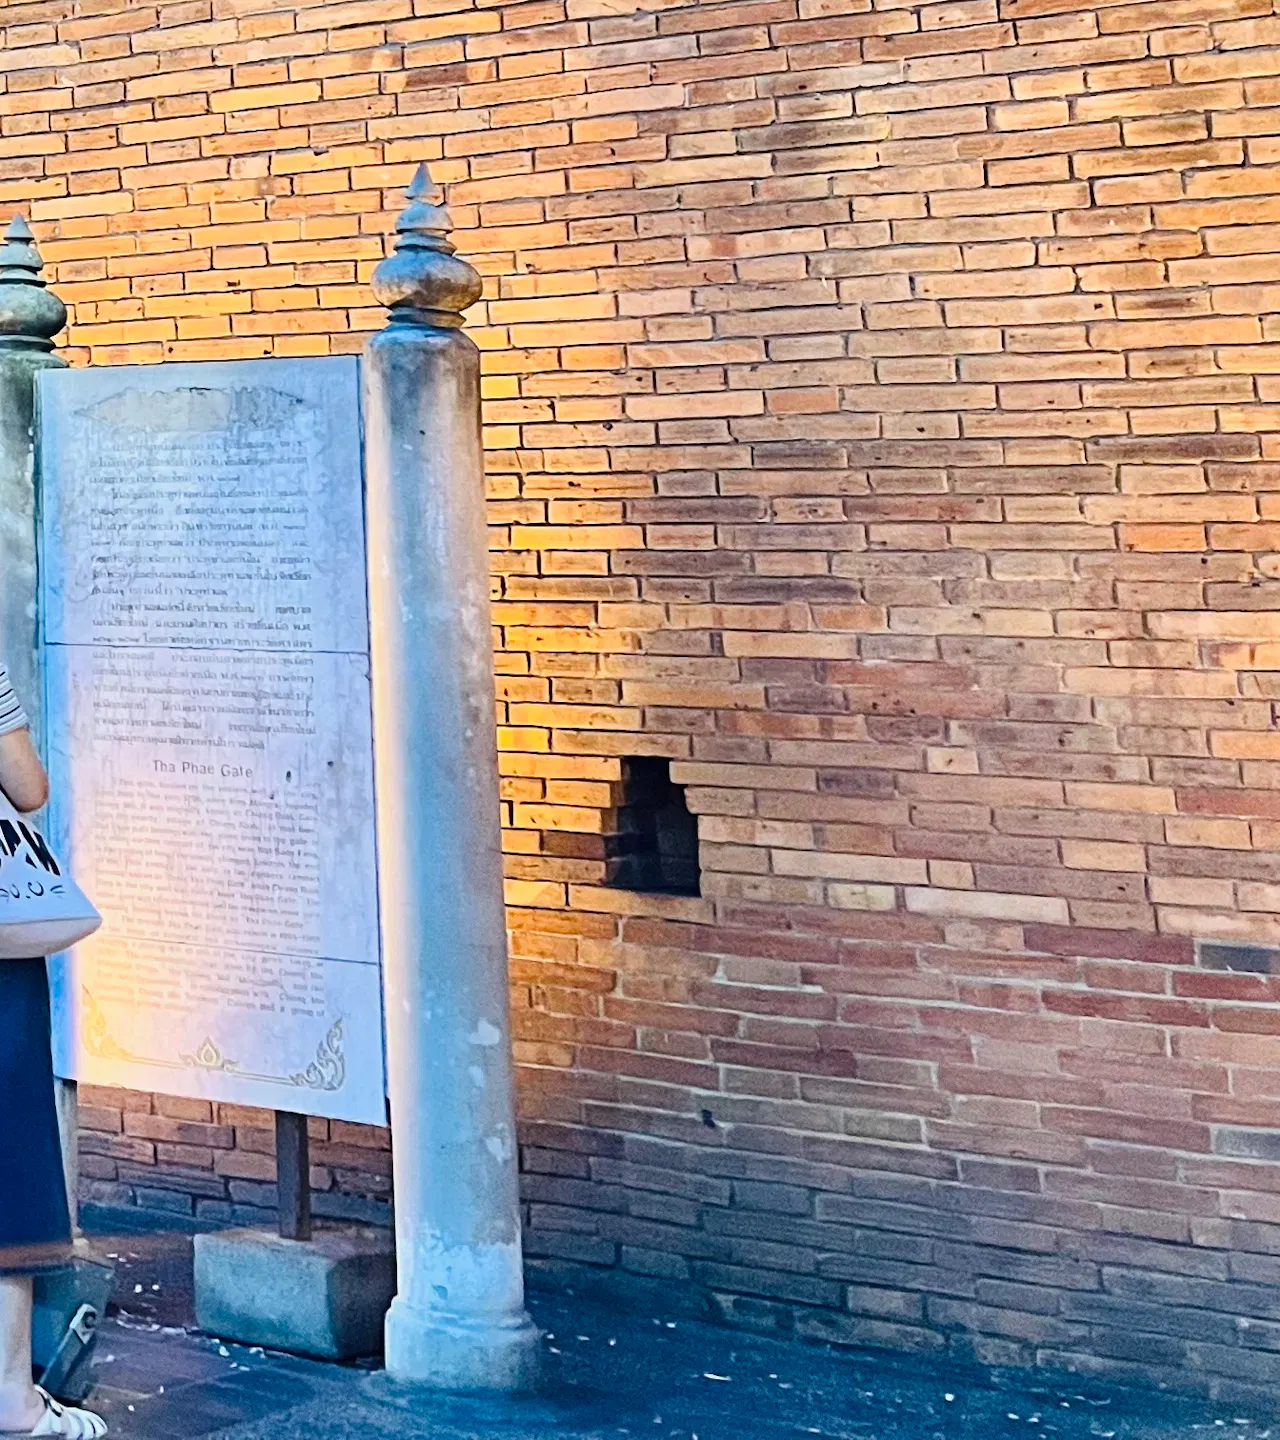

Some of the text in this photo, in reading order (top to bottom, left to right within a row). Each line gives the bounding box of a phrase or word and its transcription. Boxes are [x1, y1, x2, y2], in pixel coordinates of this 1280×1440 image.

[153, 759, 253, 777] Tha Phae Gate
